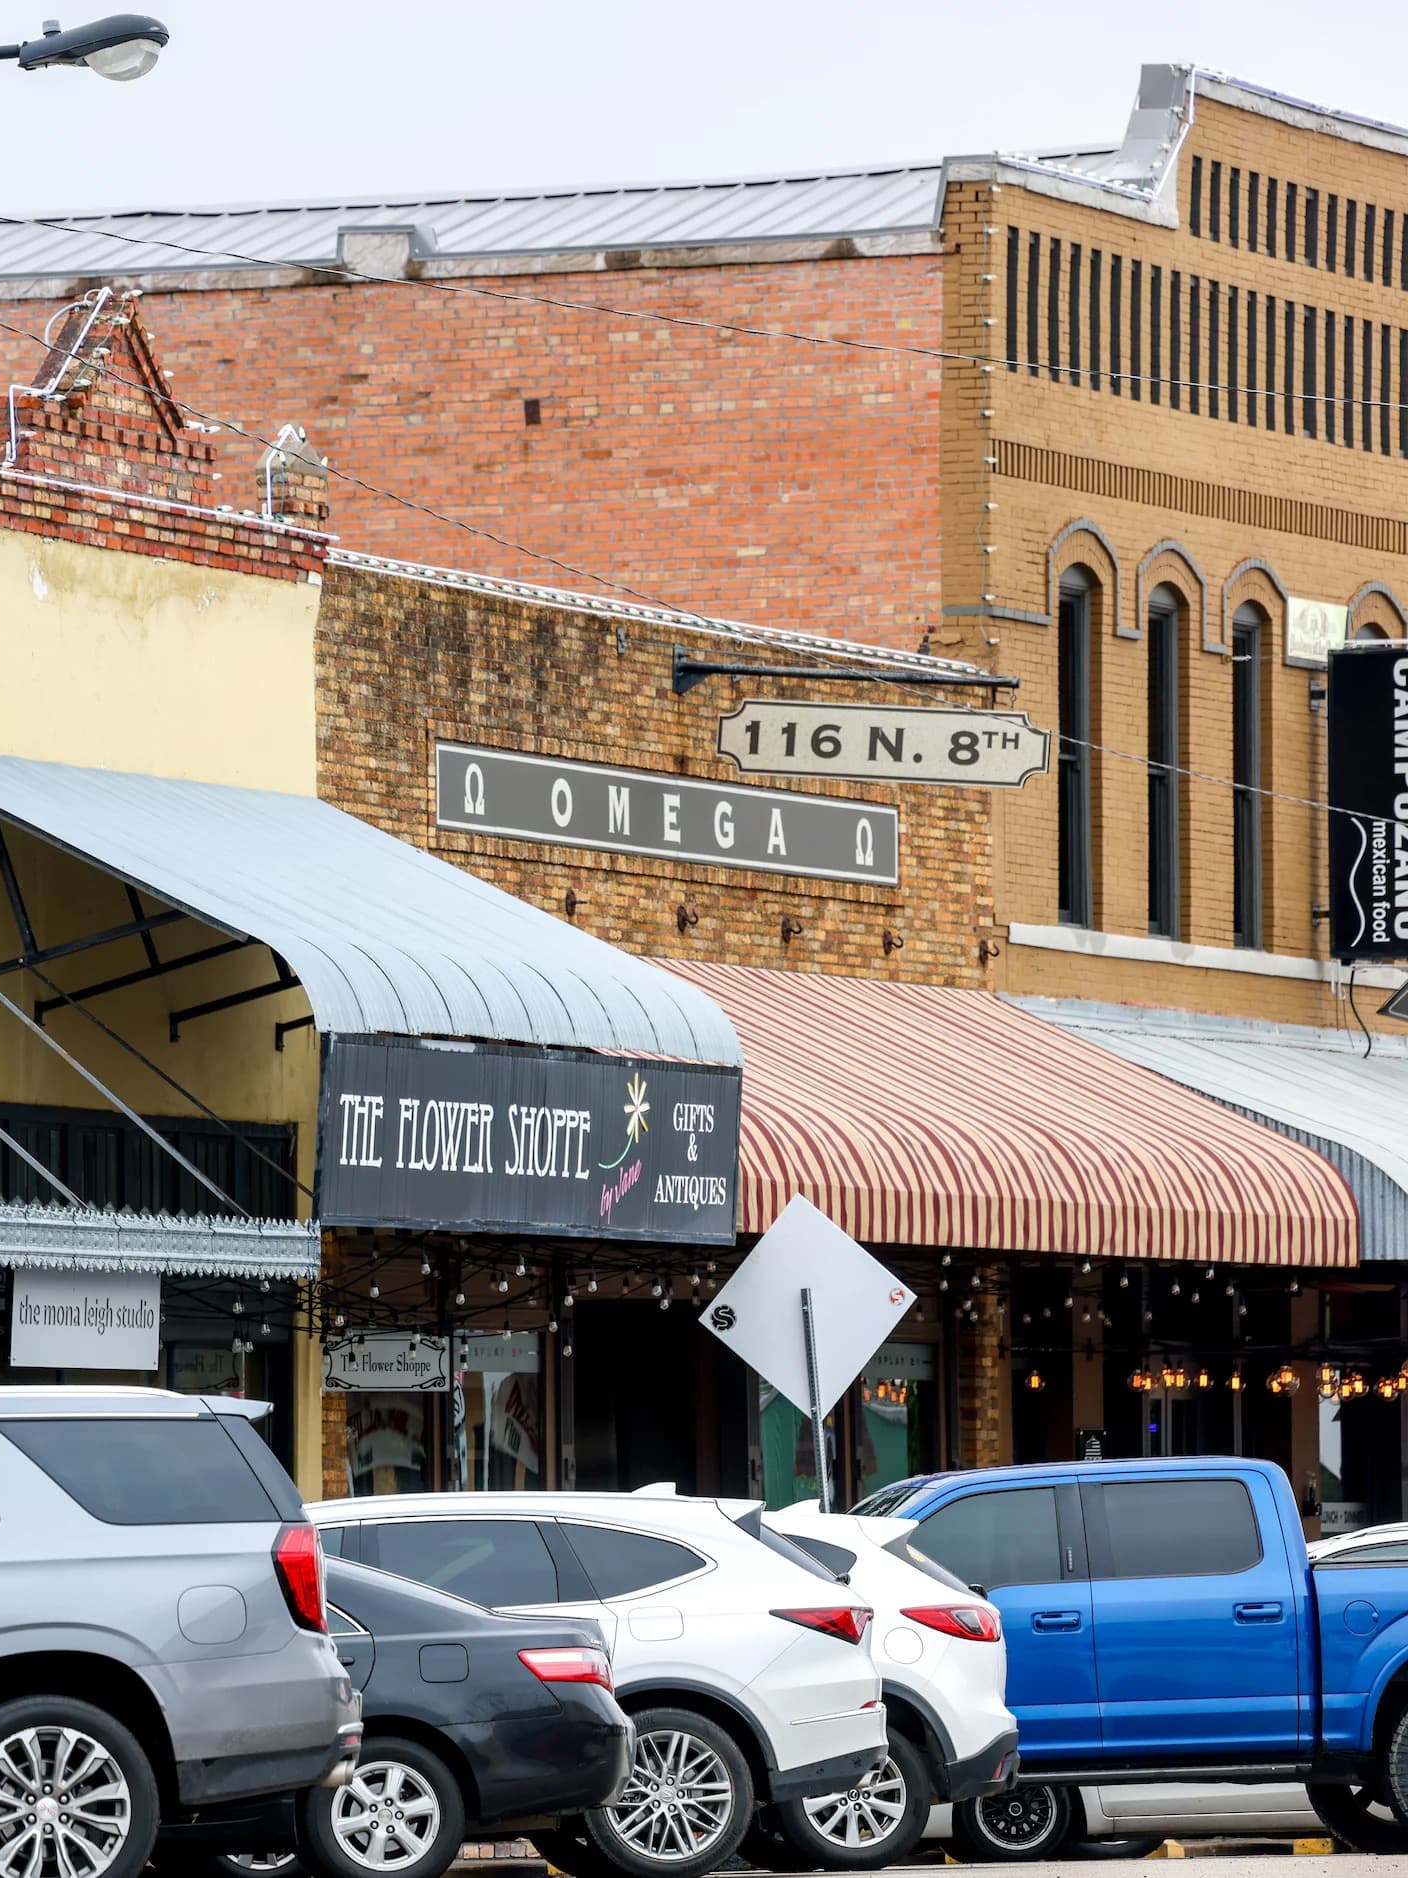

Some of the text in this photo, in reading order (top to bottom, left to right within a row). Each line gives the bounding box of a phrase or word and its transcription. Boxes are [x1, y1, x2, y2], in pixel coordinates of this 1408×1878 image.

[744, 720, 1020, 766] 116 N. 8TH
[551, 777, 787, 857] OMEGA
[1372, 821, 1390, 943] mexican food
[339, 1094, 591, 1181] THE FLOWER SHOPPE
[672, 1102, 715, 1135] GIFTS
[687, 1133, 698, 1163] &
[600, 1183, 613, 1225] by
[654, 1174, 727, 1211] ANTIQUES
[19, 1294, 155, 1336] the mona leigh studio
[361, 1352, 394, 1373] Flower
[396, 1352, 432, 1377] Shoppe
